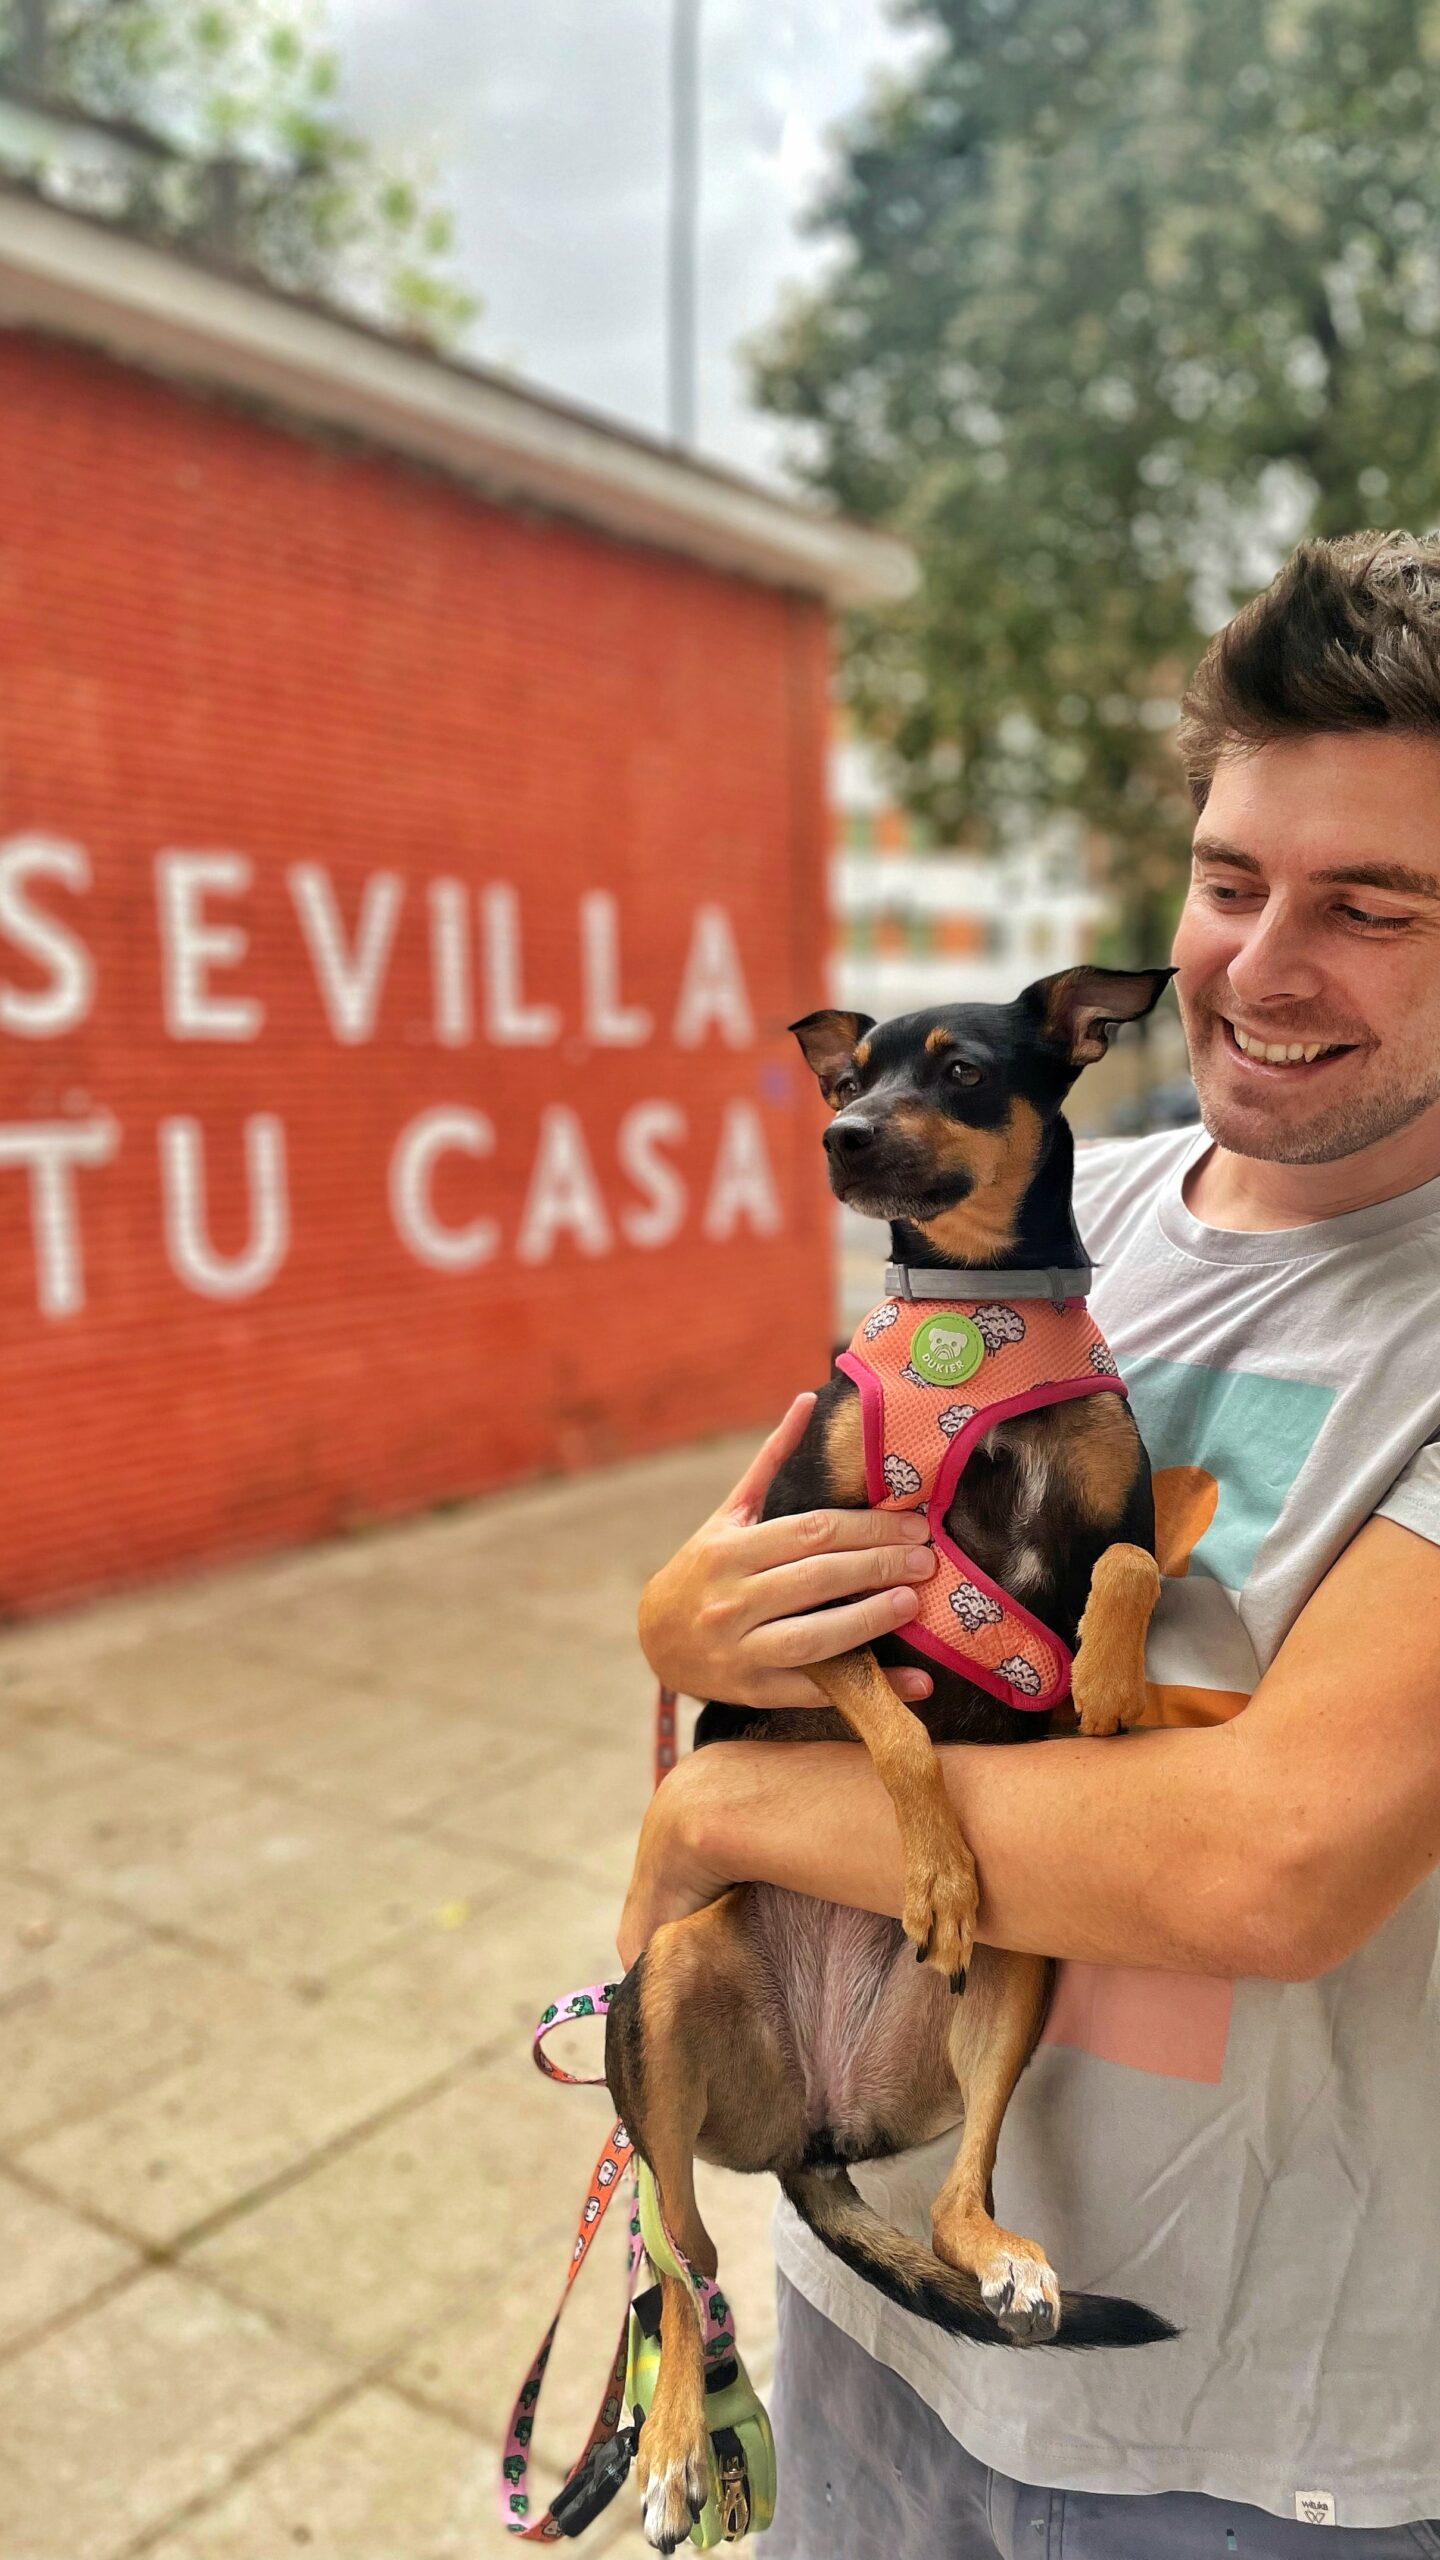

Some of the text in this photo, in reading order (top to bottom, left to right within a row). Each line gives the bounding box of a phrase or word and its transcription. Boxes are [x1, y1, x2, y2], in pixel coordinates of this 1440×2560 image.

[0, 831, 756, 1051] SEVILLA
[0, 1098, 783, 1319] TU CASA
[922, 1353, 965, 1374] DUKIER
